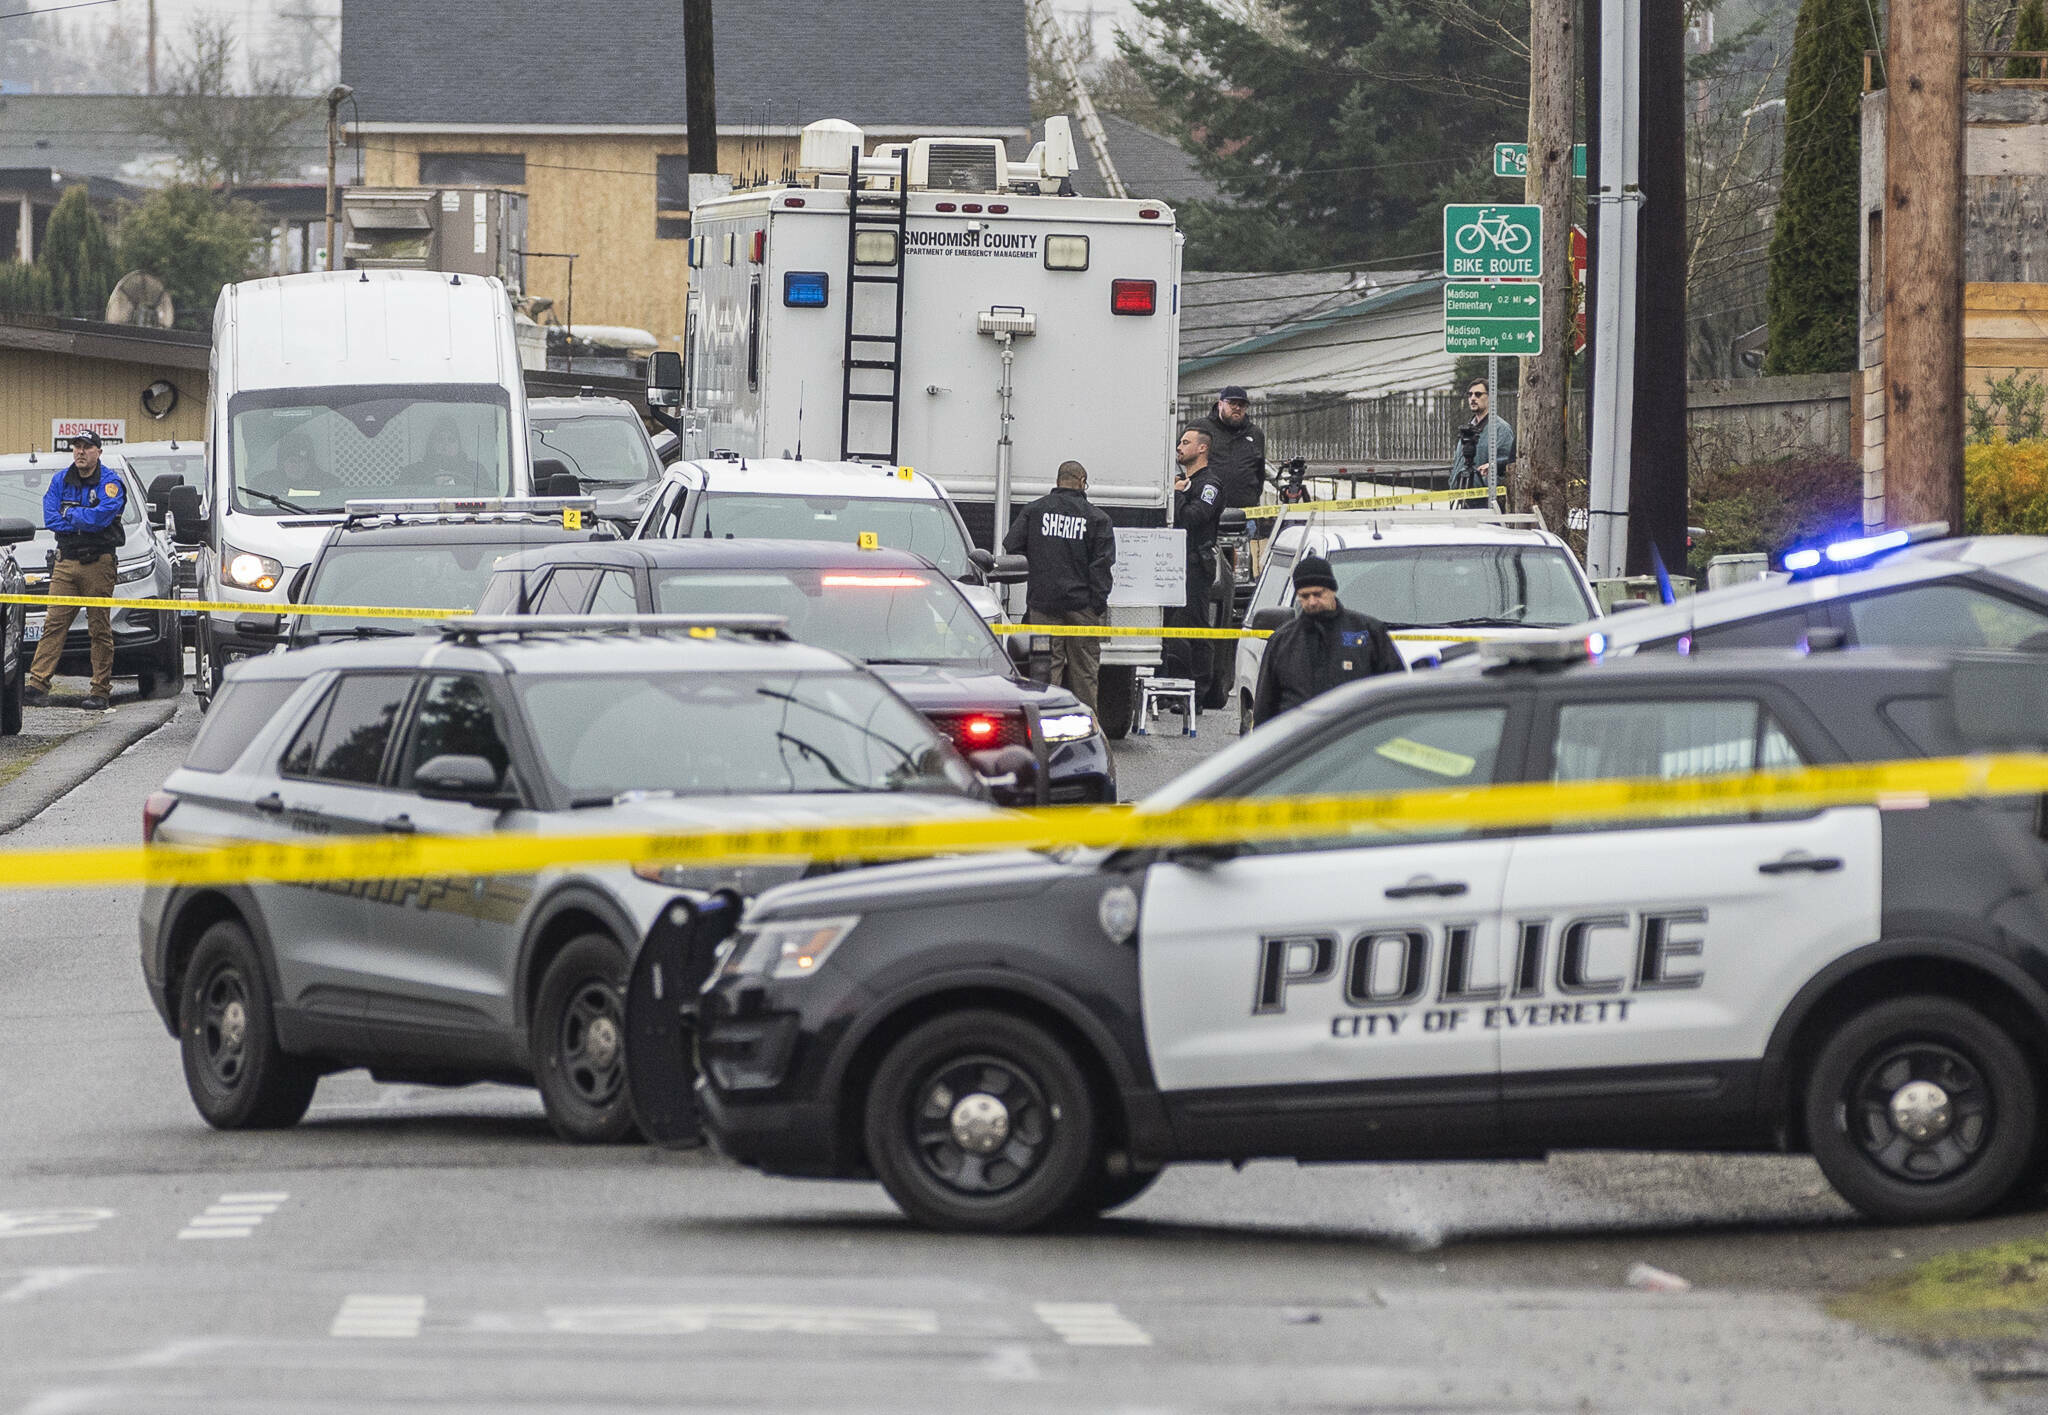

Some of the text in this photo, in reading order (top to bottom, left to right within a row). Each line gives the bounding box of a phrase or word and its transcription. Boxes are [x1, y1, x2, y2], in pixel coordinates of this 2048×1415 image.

[905, 231, 1037, 249] SNOHOMISH COUNTY
[954, 249, 992, 258] EMERGENCY
[993, 250, 1038, 259] MANAGEMENT
[1454, 258, 1533, 273] BIKE ROUTE
[1447, 289, 1479, 299] Madison
[1498, 295, 1509, 304] 0.2
[1447, 301, 1493, 312] Elementary
[1447, 324, 1481, 335] Madison
[1447, 335, 1499, 348] Morgan Park
[1501, 332, 1513, 341] 0.6
[56, 440, 66, 449] NO
[902, 468, 909, 478] 1
[1364, 499, 1372, 507] DO
[1386, 496, 1402, 505] POLICE
[568, 512, 576, 523] 2
[1041, 512, 1087, 541] SHERIFF
[865, 534, 873, 545] 3
[1251, 904, 1710, 1018] POLICE
[1329, 996, 1636, 1040] CITY OF EVERETT
